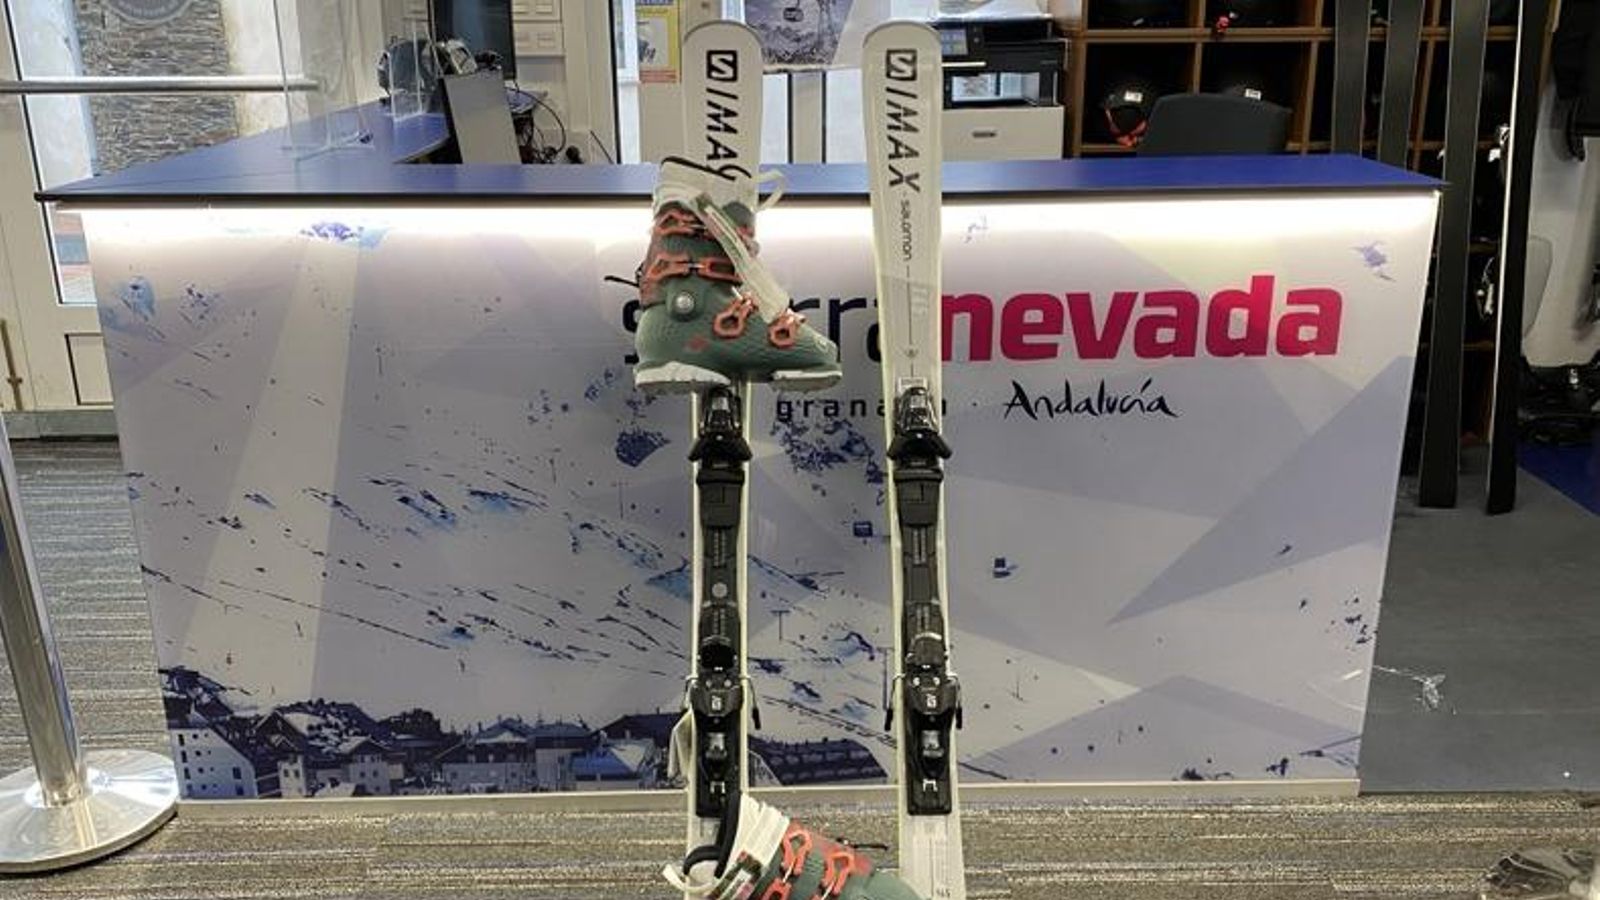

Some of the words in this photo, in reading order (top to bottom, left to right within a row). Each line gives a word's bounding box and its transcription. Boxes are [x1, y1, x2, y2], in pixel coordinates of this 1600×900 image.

[706, 50, 739, 171] S/MA
[941, 275, 1343, 362] nevada
[1004, 379, 1178, 420] Andalucía
